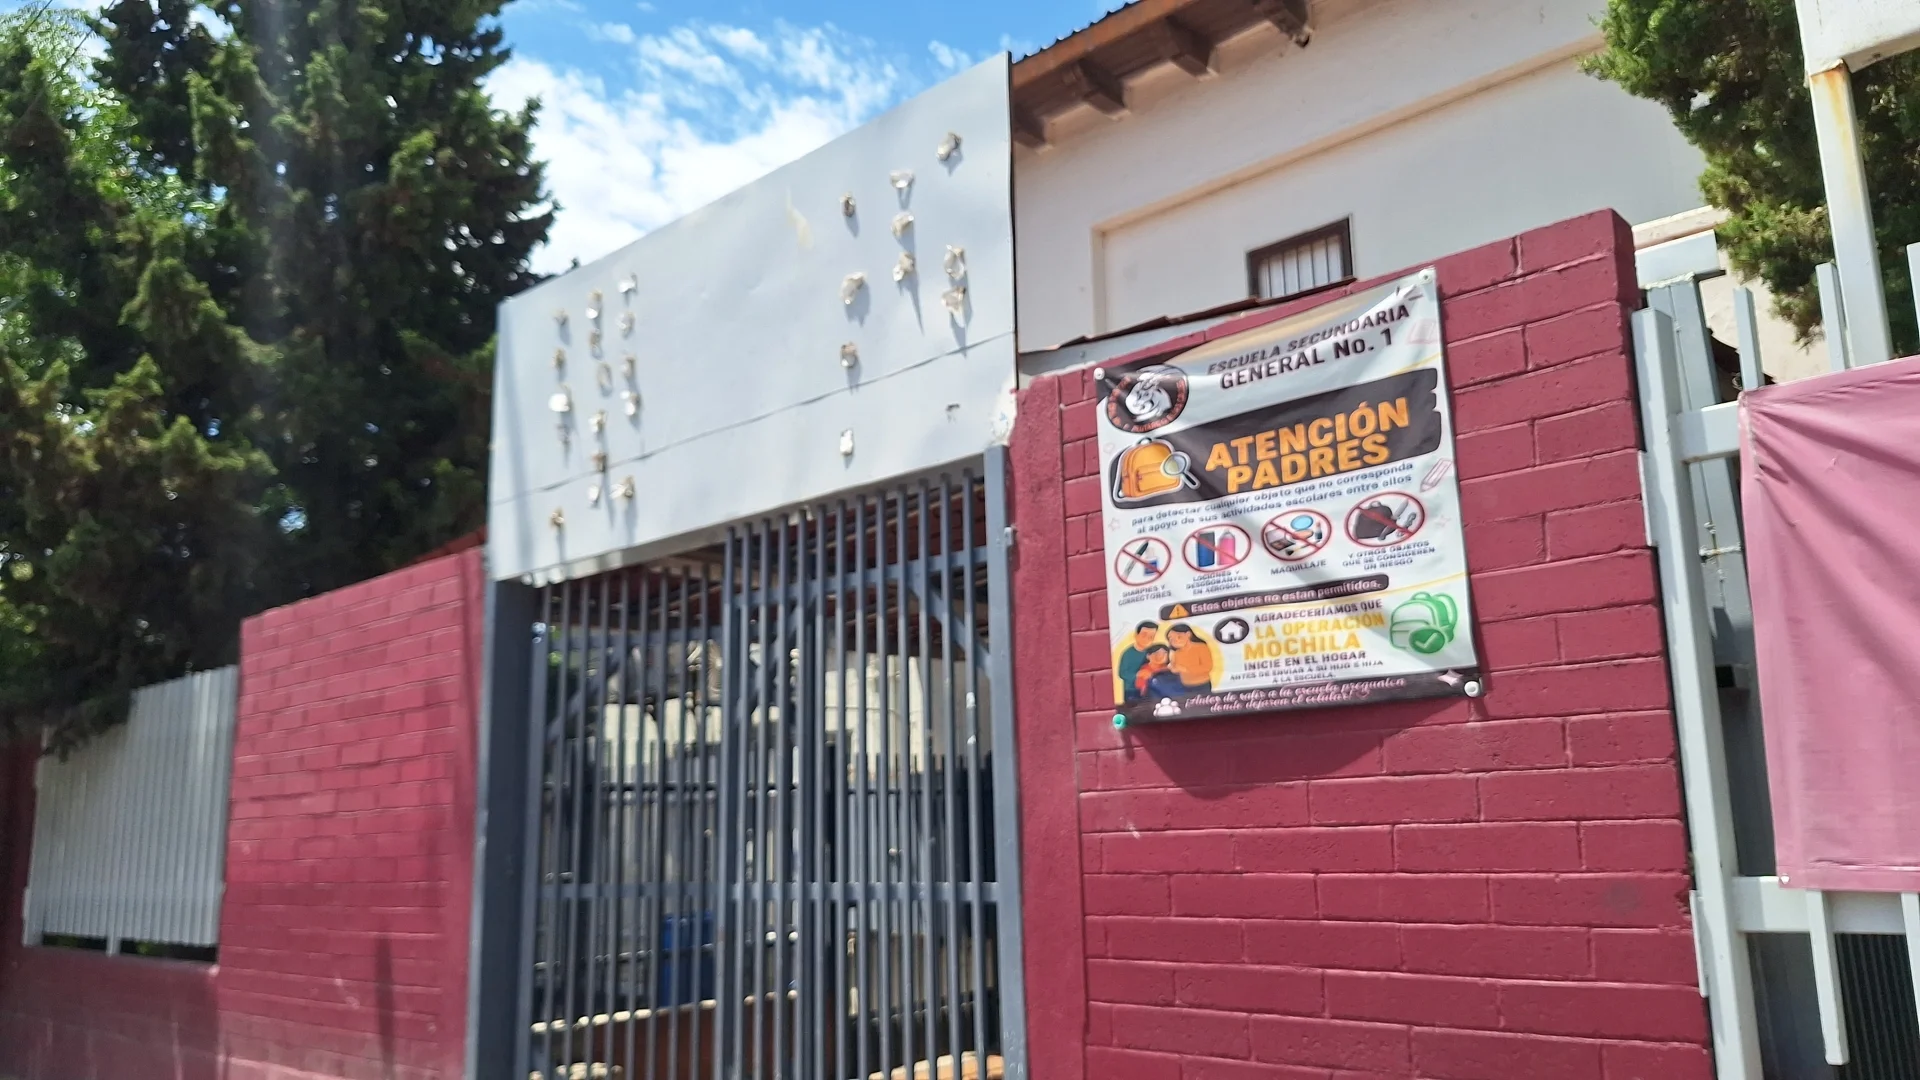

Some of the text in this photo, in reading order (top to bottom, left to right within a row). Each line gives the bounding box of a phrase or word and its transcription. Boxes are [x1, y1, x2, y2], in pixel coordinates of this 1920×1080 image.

[1208, 304, 1410, 375] ESCUELA SECUNDARIA
[1220, 328, 1392, 389] GENERAL No. 1
[1205, 397, 1410, 472] ATENCIÓN
[1227, 433, 1390, 493] PADRES
[1132, 461, 1413, 526] para detectar cualquier objeto que no corresponda
[1148, 521, 1178, 532] apoyo
[1221, 499, 1281, 519] actividades
[1285, 489, 1342, 507] escolares
[1346, 482, 1378, 494] entre
[1382, 474, 1412, 487] ellos
[1356, 548, 1386, 558] OTROS
[1390, 540, 1430, 552] OBJETOS
[1270, 559, 1326, 575] MAQUILLAJE
[1342, 560, 1360, 568] QUE
[1380, 558, 1414, 569] RIESGO
[1191, 602, 1220, 613] Estos
[1222, 594, 1262, 609] objetos
[1264, 594, 1279, 604] no
[1282, 590, 1315, 602] estan
[1254, 599, 1382, 623] AGRADECERÍAMOS QUE
[1255, 611, 1386, 639] LA OPERACIÓN
[1244, 632, 1361, 660] MOCHILA
[1244, 650, 1366, 671] INICIE EN EL HOGAR
[1223, 692, 1238, 702] de
[1280, 686, 1293, 696] la
[1295, 682, 1340, 696] escuela
